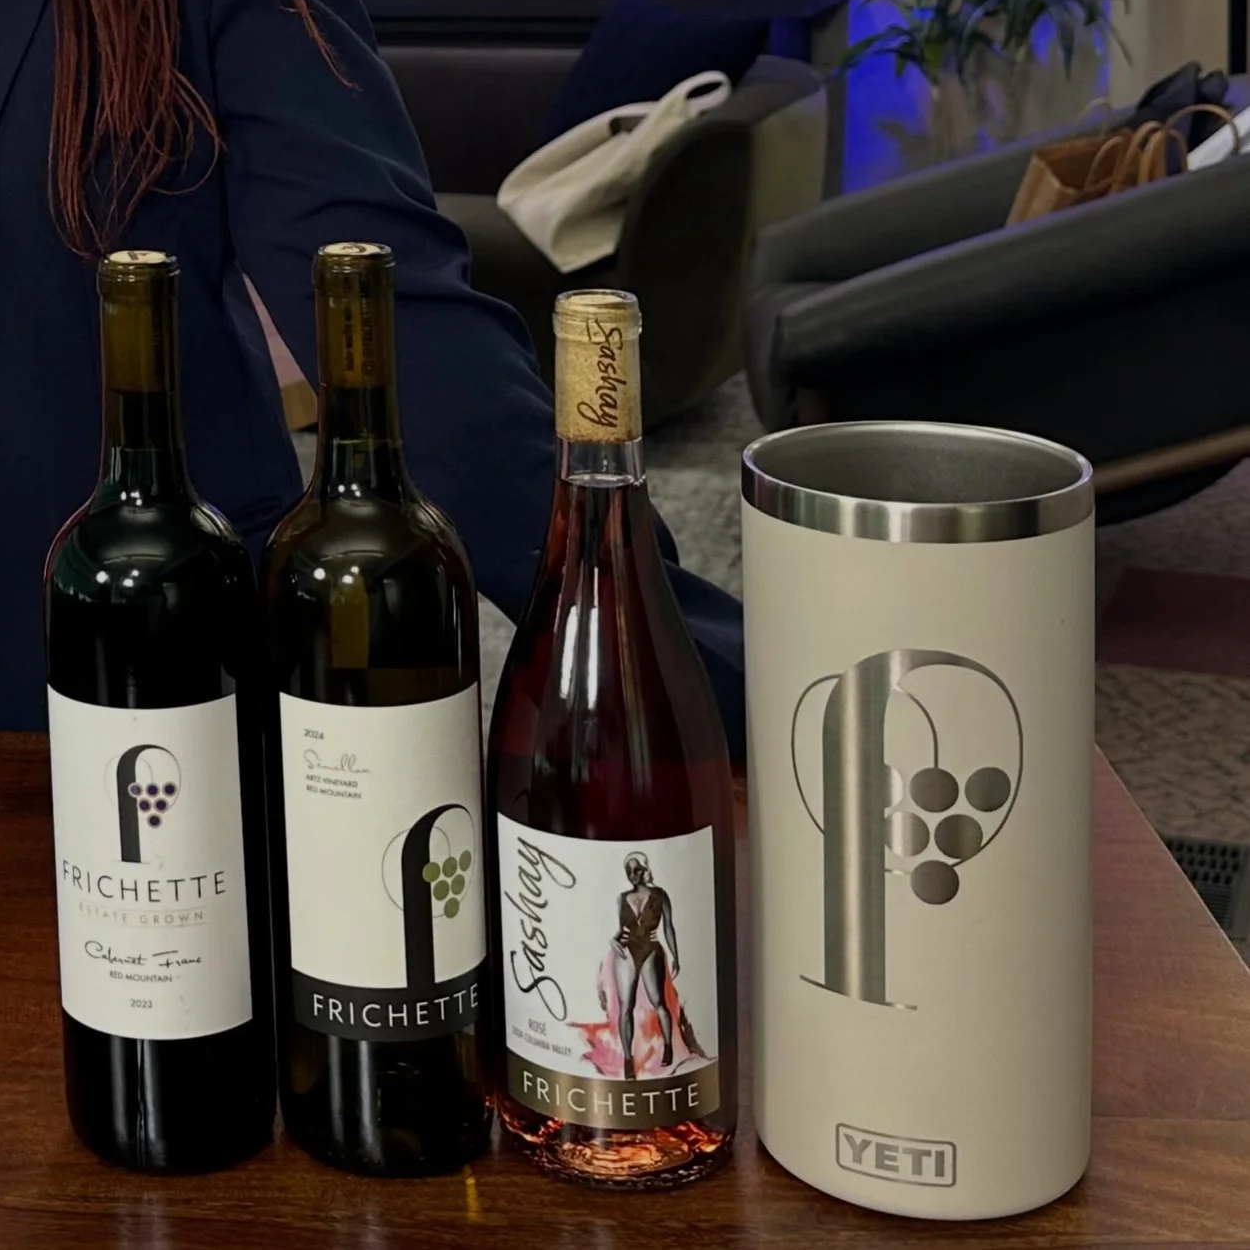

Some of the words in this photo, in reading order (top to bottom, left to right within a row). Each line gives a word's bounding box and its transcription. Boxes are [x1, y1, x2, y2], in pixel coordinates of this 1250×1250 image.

[577, 318, 627, 428] Sashay
[304, 728, 324, 740] 2024
[320, 788, 362, 799] MOUNTAIN
[62, 860, 227, 903] FRICHETTE
[78, 901, 128, 923] ESTATE
[139, 911, 204, 925] GROWN
[504, 836, 577, 1022] Sashay
[84, 940, 147, 966] Cabernet
[110, 970, 123, 980] RED
[125, 973, 173, 983] MOUNTAIN
[130, 998, 153, 1009] 2023
[313, 983, 479, 1028] FRICHETTE
[523, 1071, 699, 1116] FRICHETTE
[842, 1132, 945, 1178] YETI
